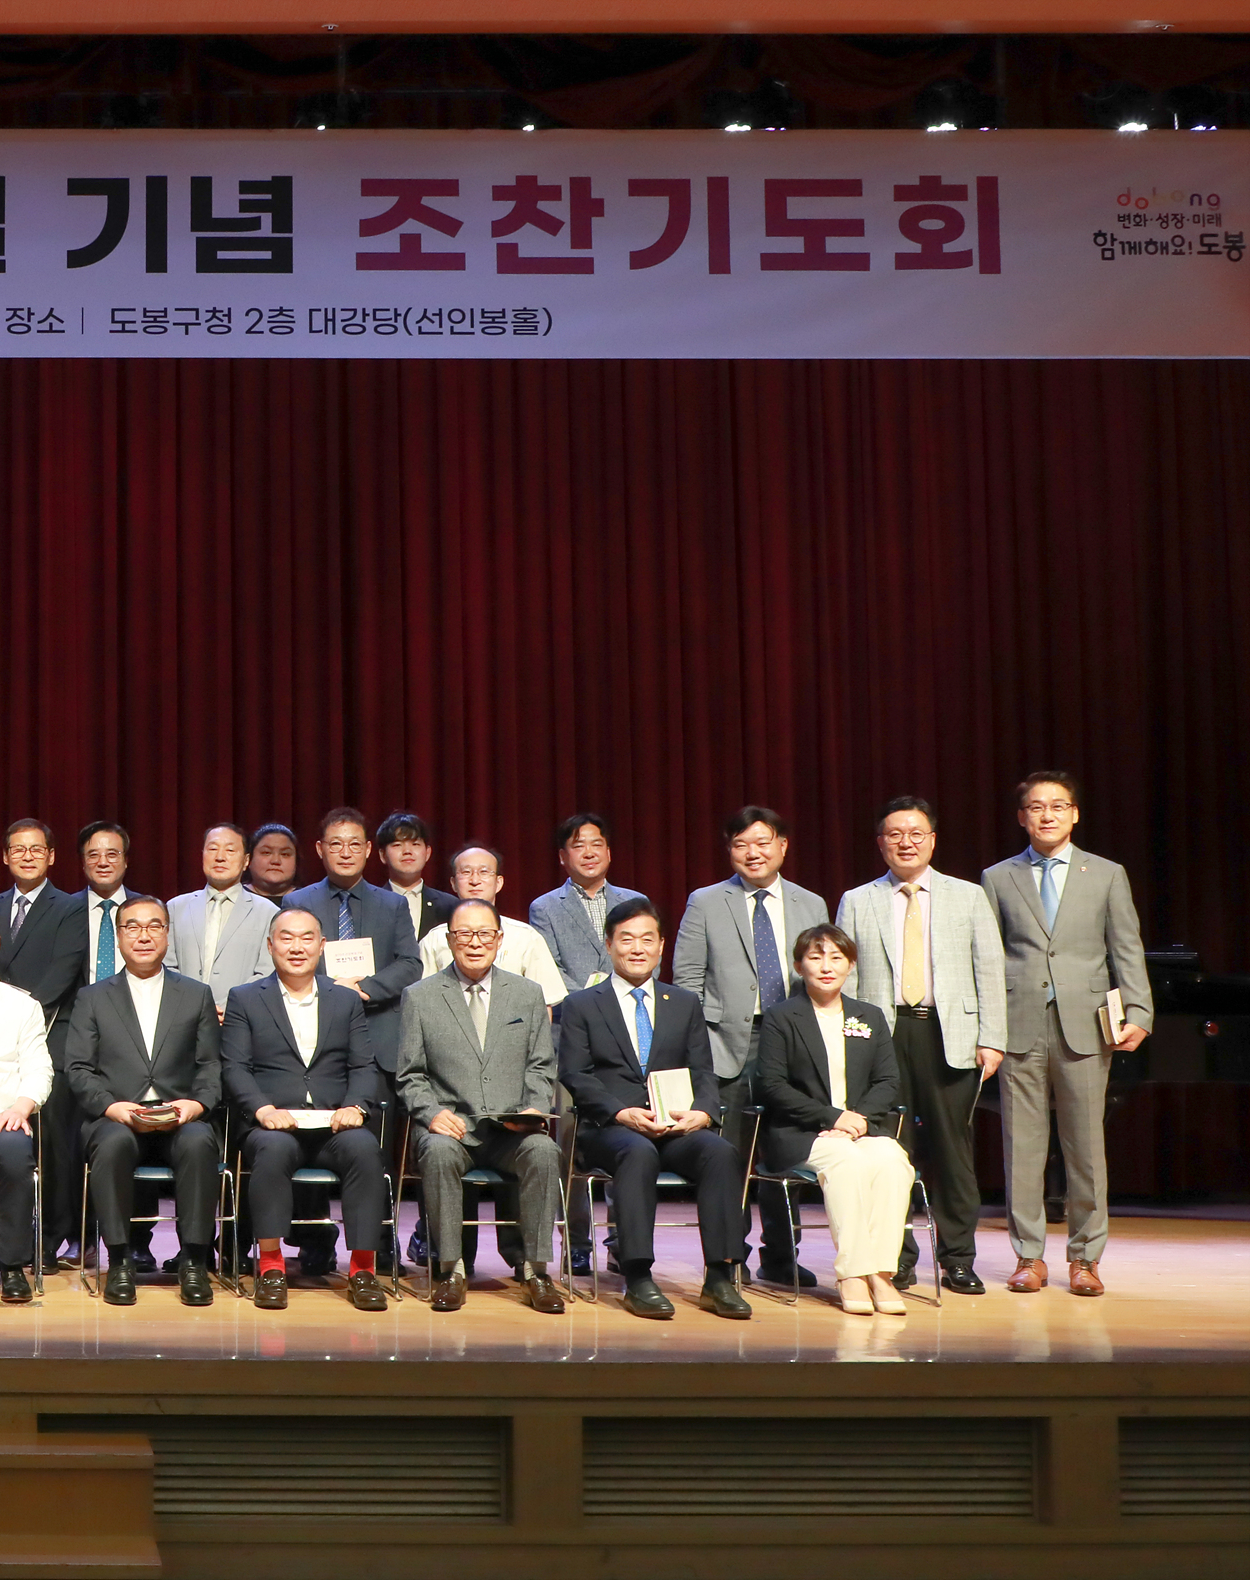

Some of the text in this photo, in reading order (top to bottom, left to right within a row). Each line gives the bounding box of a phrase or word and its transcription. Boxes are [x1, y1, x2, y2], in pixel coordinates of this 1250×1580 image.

[66, 175, 294, 274] 기념
[355, 174, 1002, 275] 조찬기도회
[1093, 229, 1246, 263] 함께해요! 도봉
[5, 306, 553, 337] 장소 도봉구청 2층 대강당(선인봉홀)
